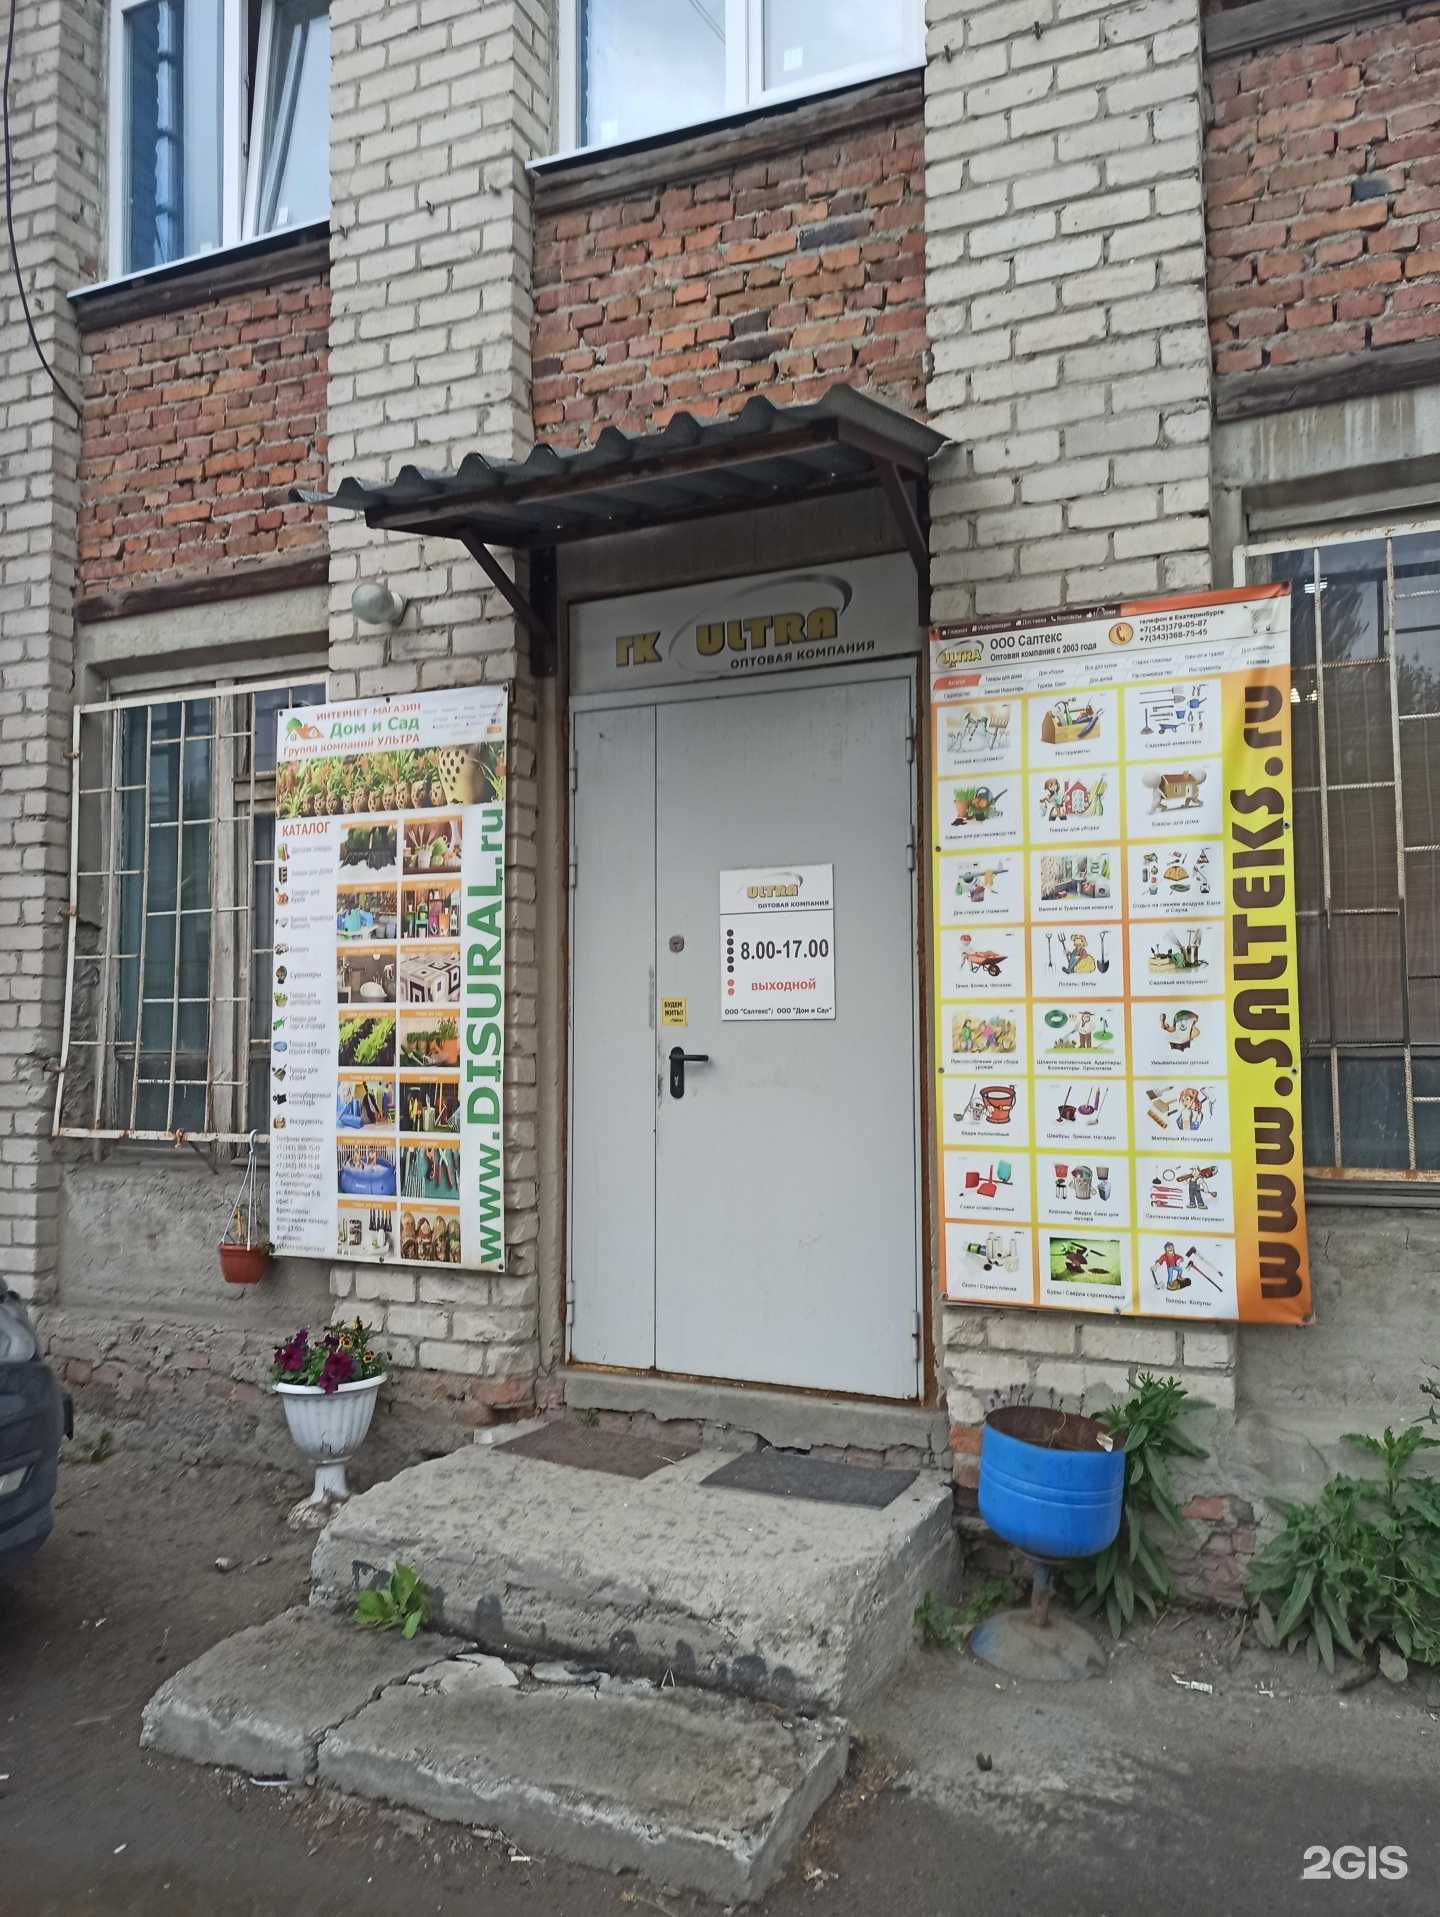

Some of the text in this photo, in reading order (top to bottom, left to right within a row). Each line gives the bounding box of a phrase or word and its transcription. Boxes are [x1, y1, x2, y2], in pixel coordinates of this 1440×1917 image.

[696, 606, 838, 656] ULTRA
[990, 632, 1063, 650] ООО Салтекс
[615, 630, 662, 668] ГК
[730, 639, 876, 670] ОПТОВАЯ КОМПАНИЯ
[990, 652, 1020, 662] Оптовая
[1021, 647, 1055, 658] компания
[329, 717, 366, 740] Дом
[371, 720, 382, 732] и
[387, 715, 420, 732] Сад
[283, 734, 420, 758] Группа компаний УЛЬТРА
[282, 821, 331, 838] КАТАЛОГ
[746, 883, 799, 899] ULTRA
[757, 899, 830, 909] ОПТОВАЯ КОМПАНИЯ
[740, 938, 830, 960] 8.00-17.00
[1230, 684, 1304, 1302] www.SALTEKS.ru
[466, 807, 504, 1265] www.DISURAL.ru
